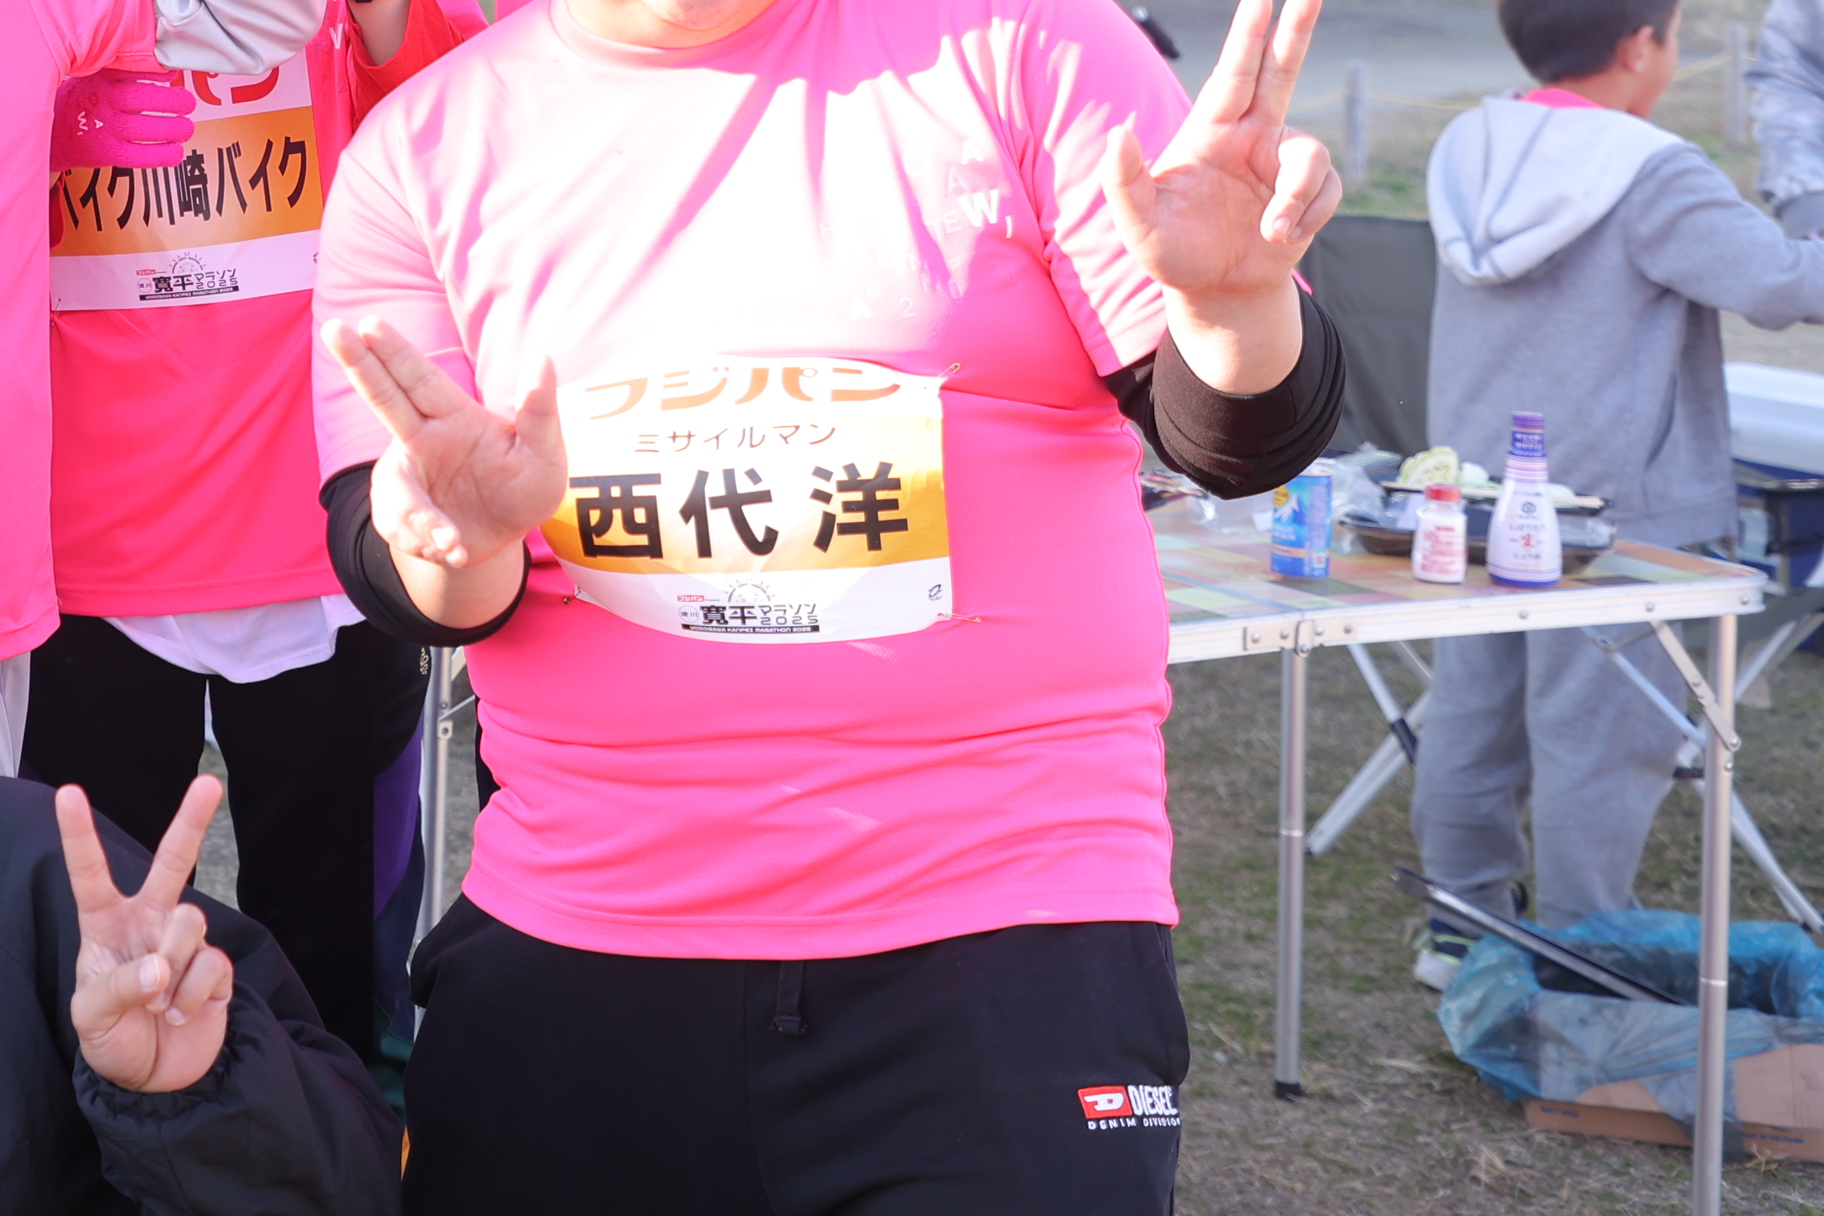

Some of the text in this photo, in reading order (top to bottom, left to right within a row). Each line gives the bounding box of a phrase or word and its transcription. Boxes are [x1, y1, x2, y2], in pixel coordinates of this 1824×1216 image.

[584, 365, 902, 421] フジパン
[634, 423, 836, 454] ミサイルマン
[759, 615, 819, 626] 2025
[1127, 1084, 1178, 1116] DIESEL
[1087, 1116, 1137, 1130] DENIM
